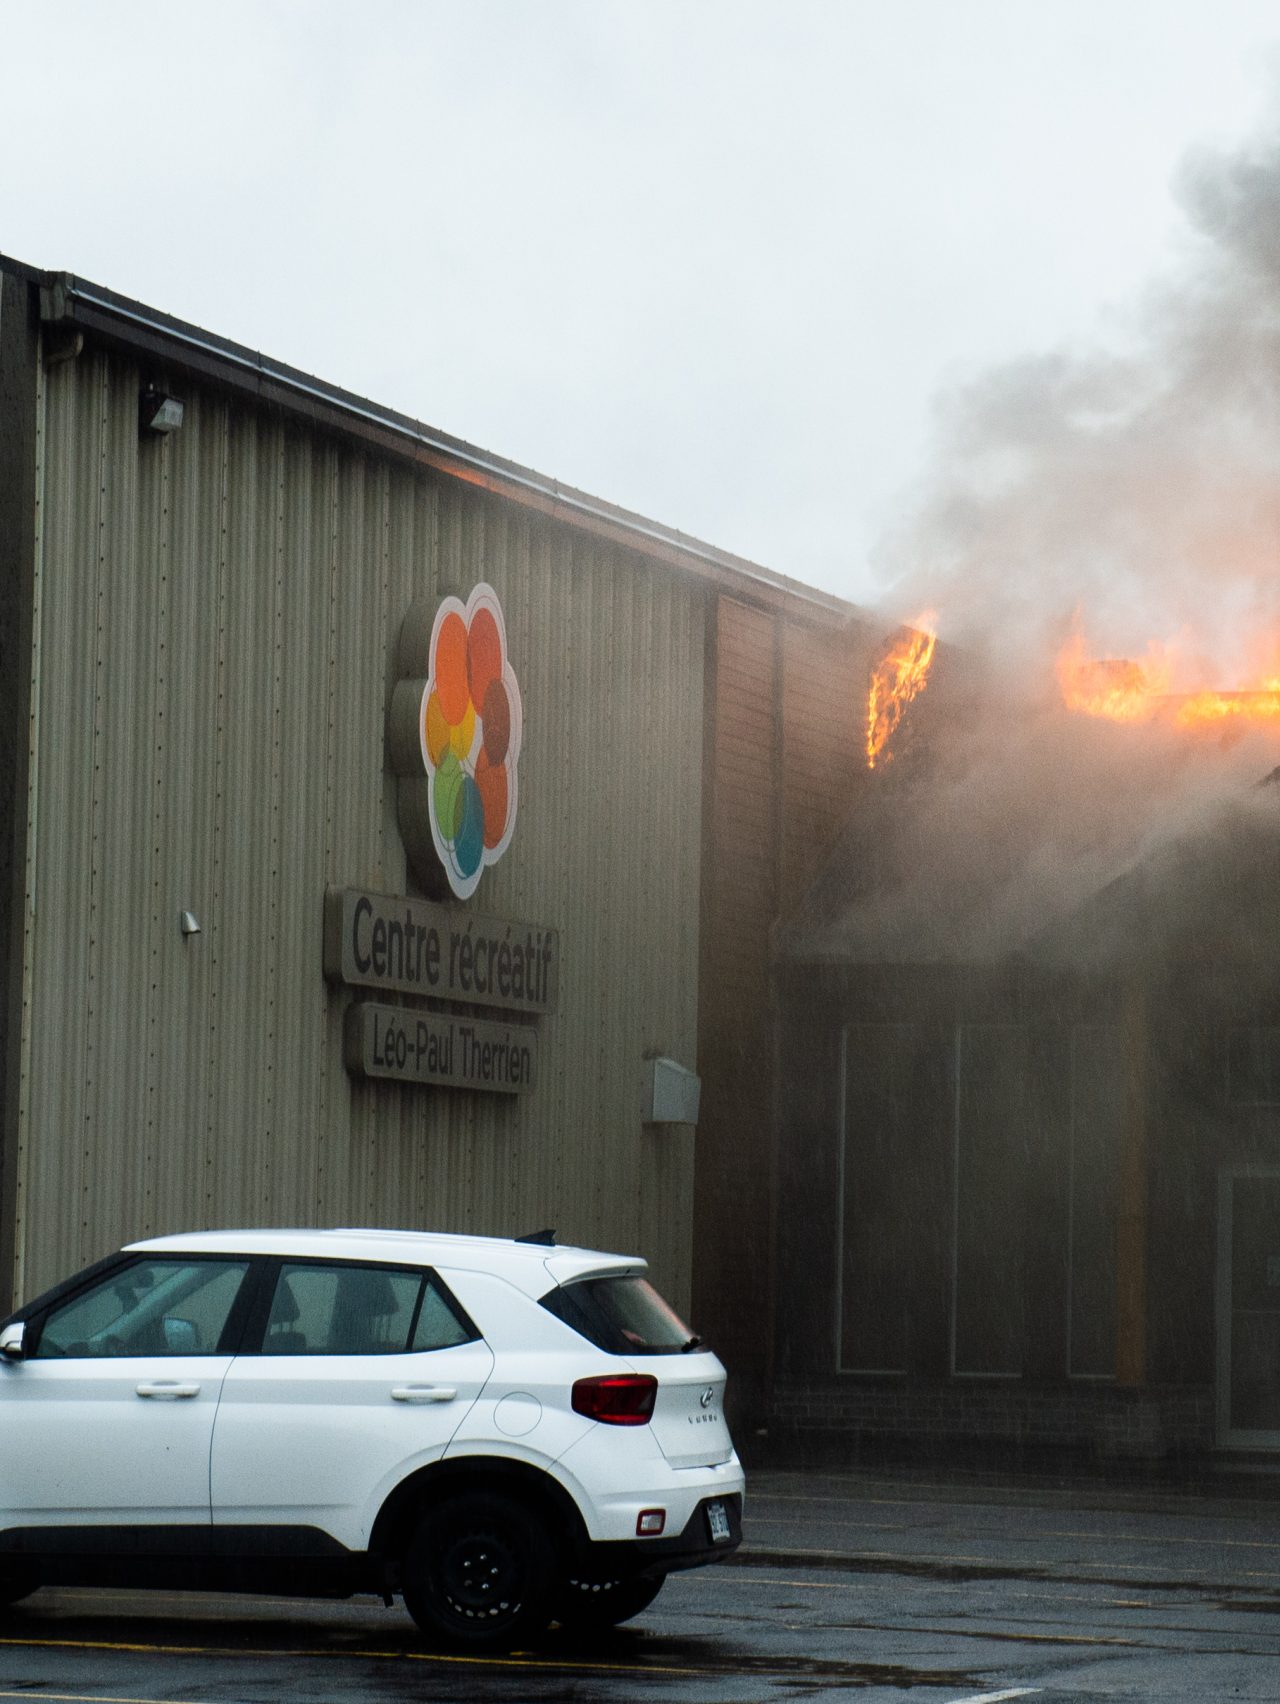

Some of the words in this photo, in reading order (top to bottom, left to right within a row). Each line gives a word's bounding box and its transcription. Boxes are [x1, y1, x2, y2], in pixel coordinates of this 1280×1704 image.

[352, 896, 440, 985] Centre
[449, 921, 552, 1003] récréatif
[372, 1013, 453, 1075] Léo-Paul
[459, 1026, 530, 1085] Therrien
